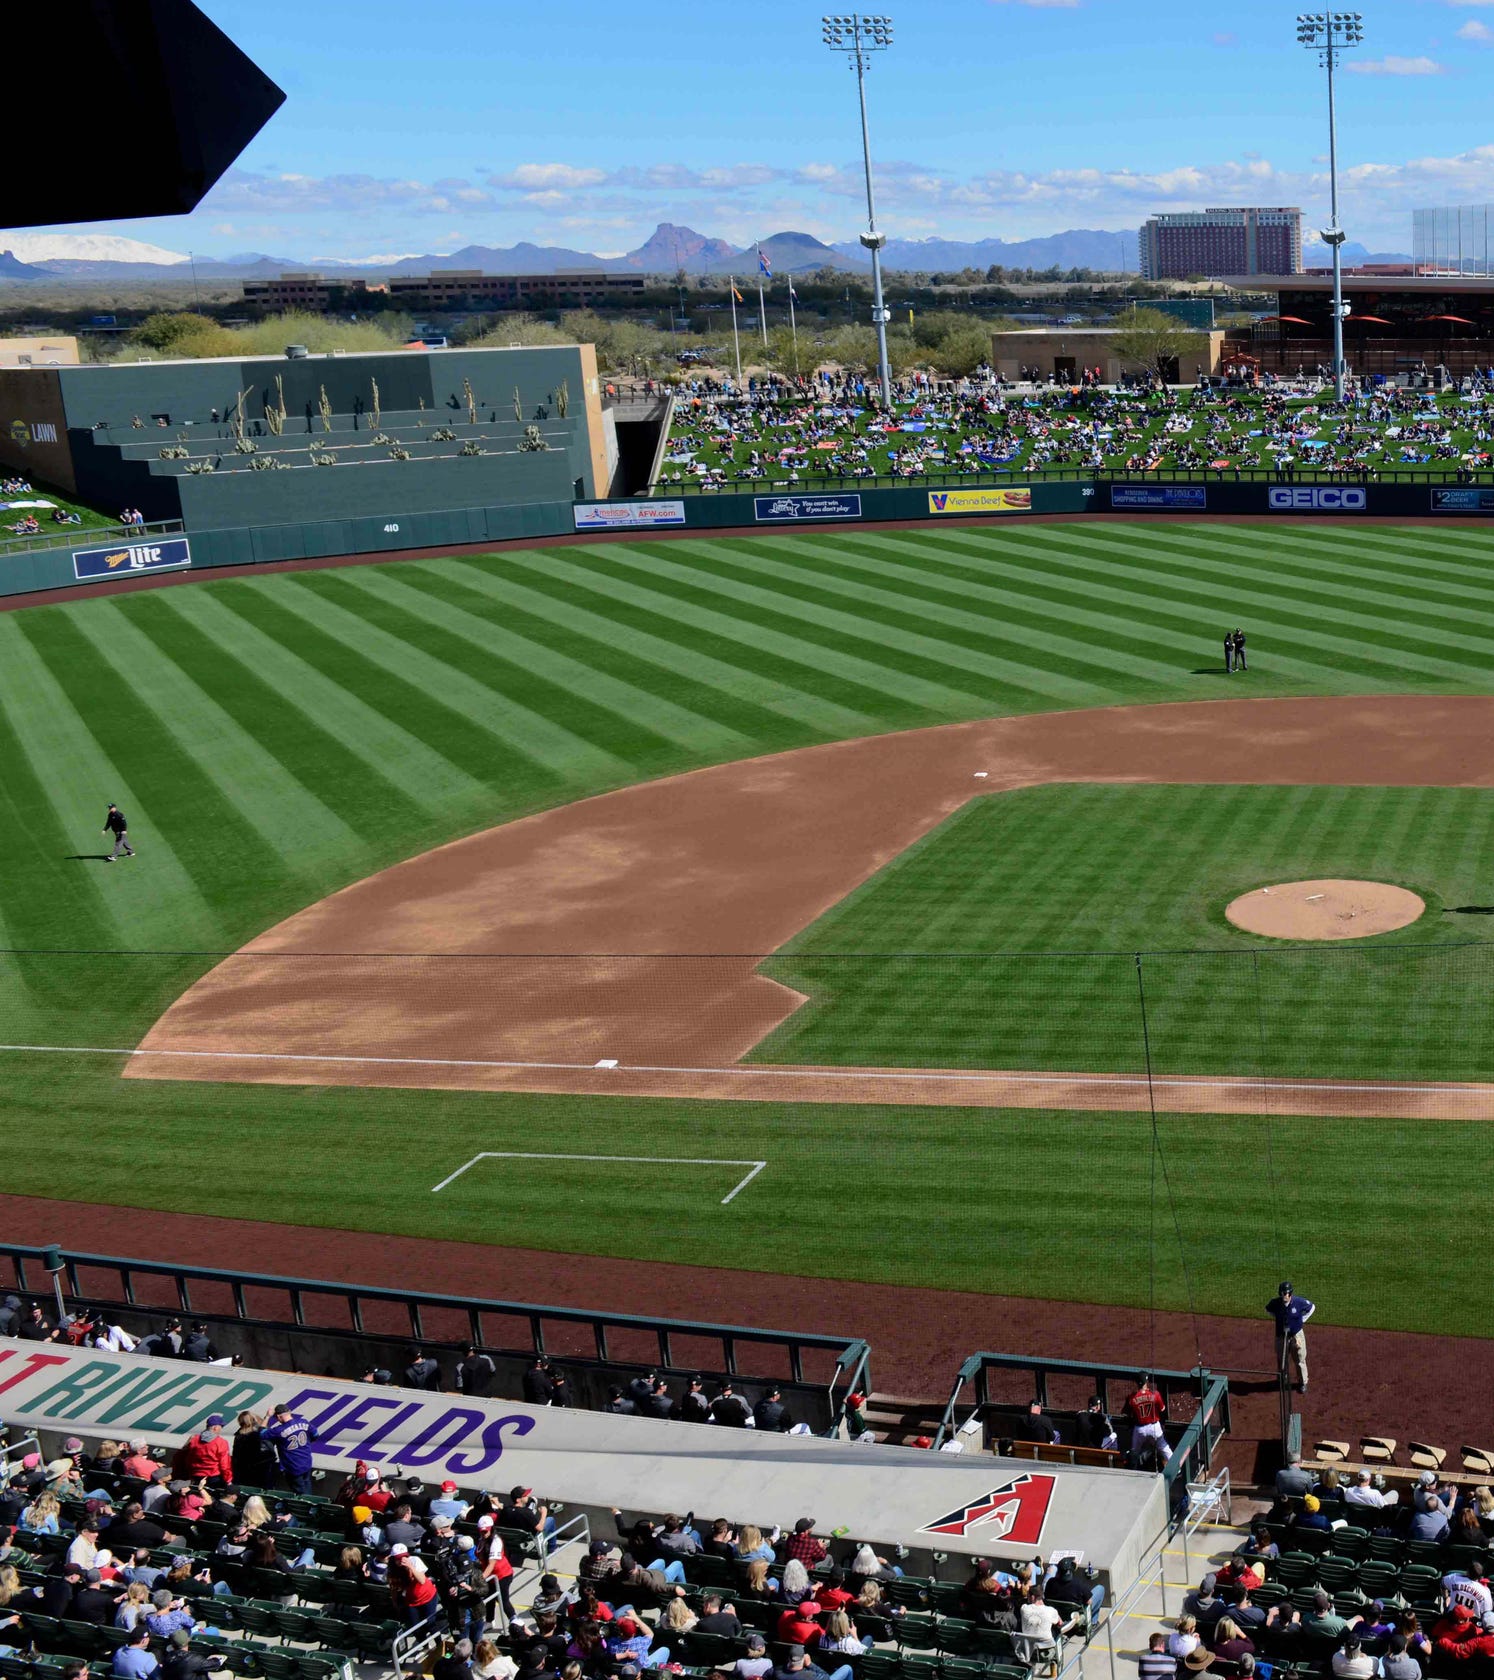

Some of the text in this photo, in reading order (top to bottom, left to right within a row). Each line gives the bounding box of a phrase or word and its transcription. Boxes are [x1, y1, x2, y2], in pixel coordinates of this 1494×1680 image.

[31, 424, 57, 443] LAWN
[948, 495, 1001, 507] Vienna Beef
[1270, 488, 1364, 508] GEICO
[638, 509, 676, 518] AFW.com
[836, 505, 850, 513] play
[383, 523, 399, 533] 410
[127, 546, 162, 568] Lite
[15, 1360, 274, 1434] RIVER
[1138, 1402, 1153, 1419] 17
[287, 1430, 308, 1451] 20
